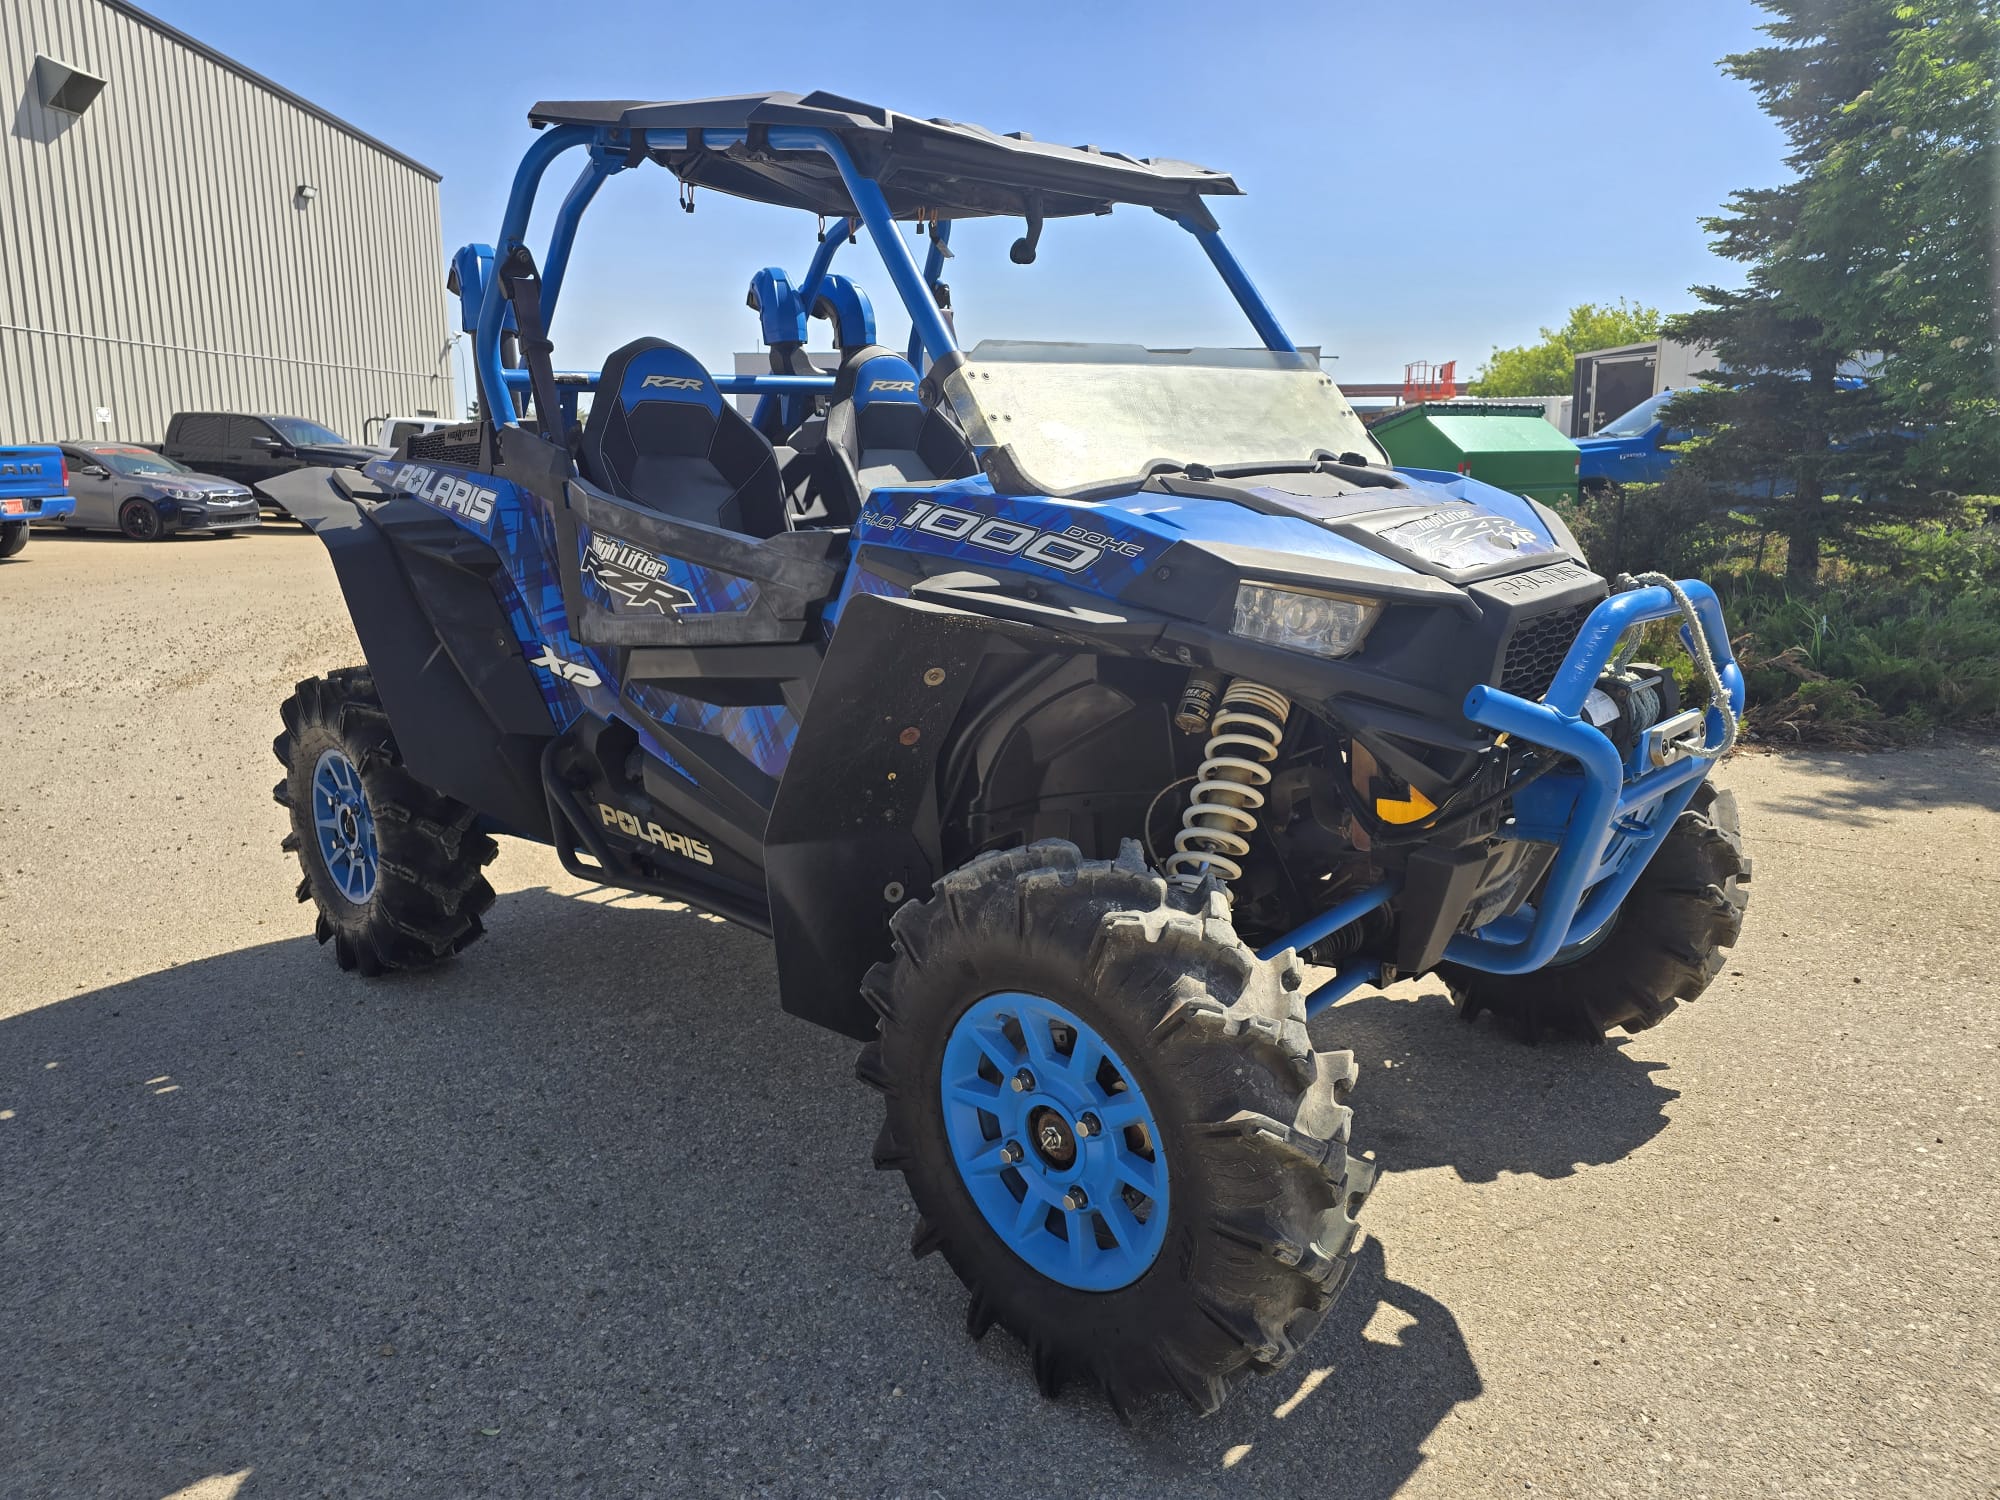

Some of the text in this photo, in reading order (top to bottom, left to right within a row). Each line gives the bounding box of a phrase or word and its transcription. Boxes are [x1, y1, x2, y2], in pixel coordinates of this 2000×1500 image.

[641, 375, 704, 391] RZR
[868, 380, 916, 392] RZR
[391, 463, 499, 524] POLARIS
[592, 533, 669, 581] High Lifter
[860, 500, 1145, 574] H.O. 1000 DOHC
[580, 545, 697, 624] RZR
[529, 644, 602, 688] XP
[598, 803, 714, 866] POLARIS
